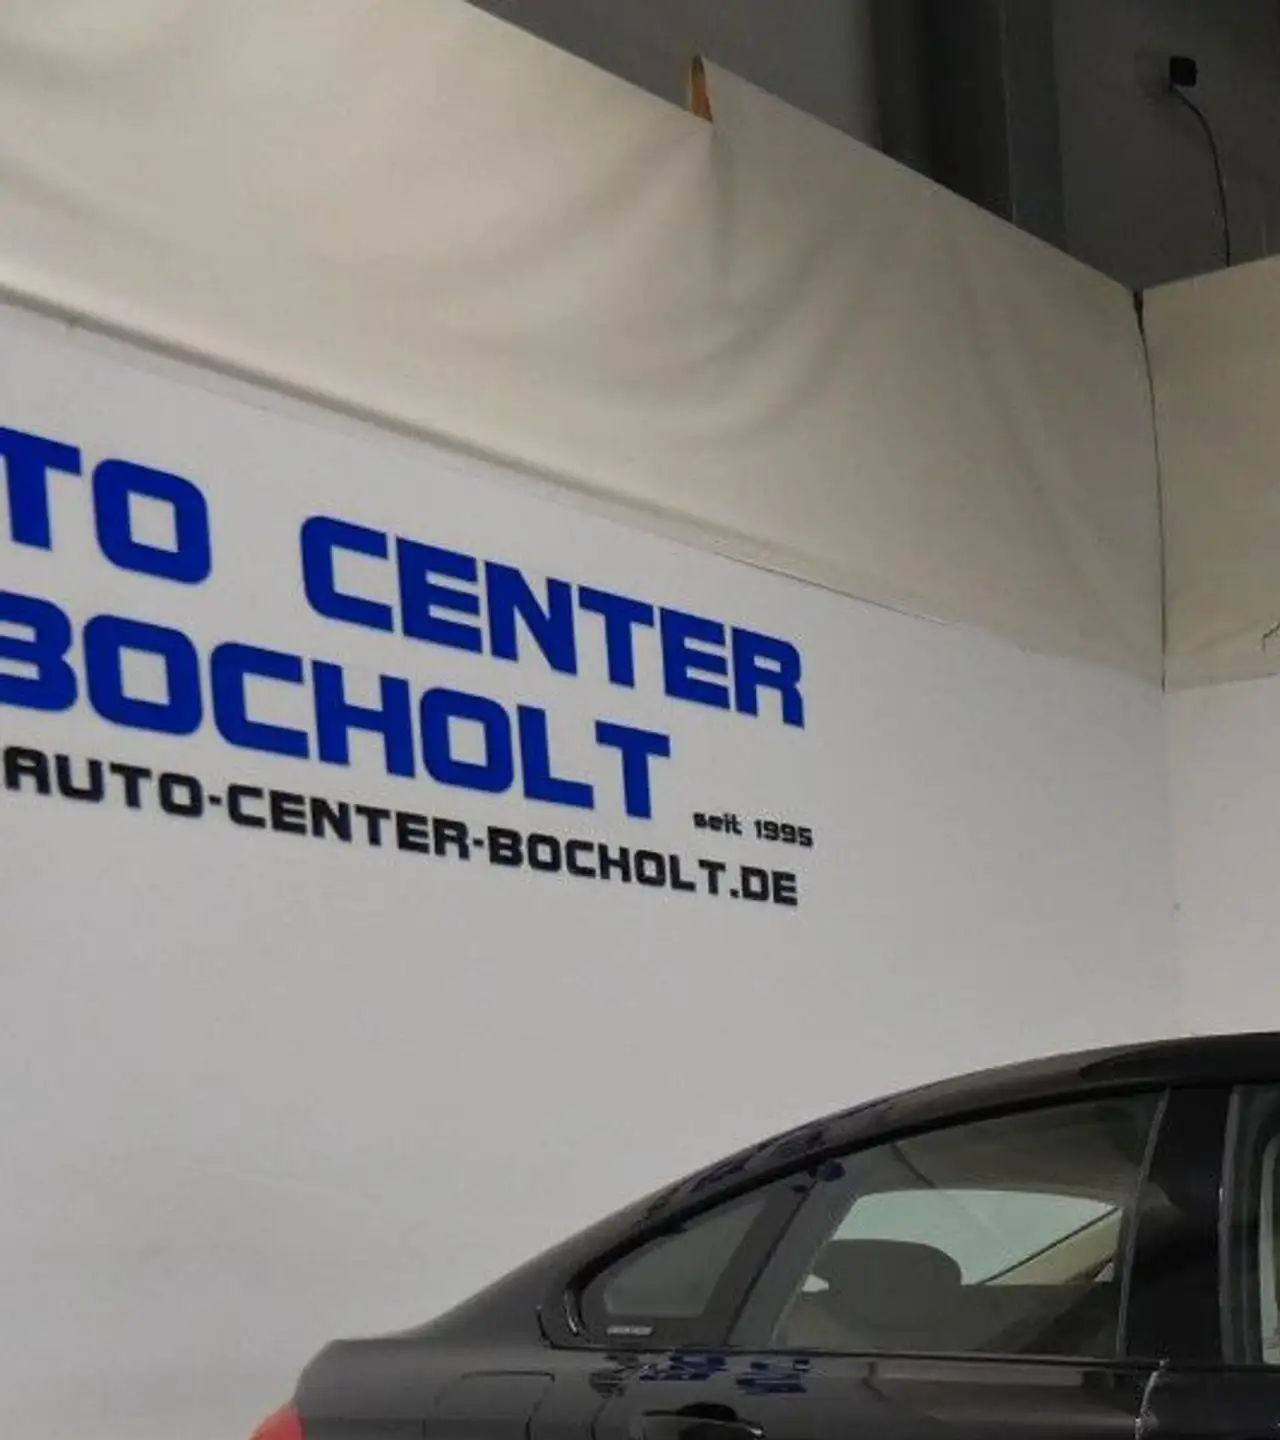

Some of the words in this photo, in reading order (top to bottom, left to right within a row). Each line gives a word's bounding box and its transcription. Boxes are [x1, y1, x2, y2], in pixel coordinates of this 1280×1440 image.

[0, 592, 671, 818] BOCHOLT
[301, 517, 804, 726] CENTER
[2, 746, 798, 907] AUTO-CENTER-BOCHOLT.DE
[693, 812, 743, 836] seit
[754, 819, 813, 848] 1995
